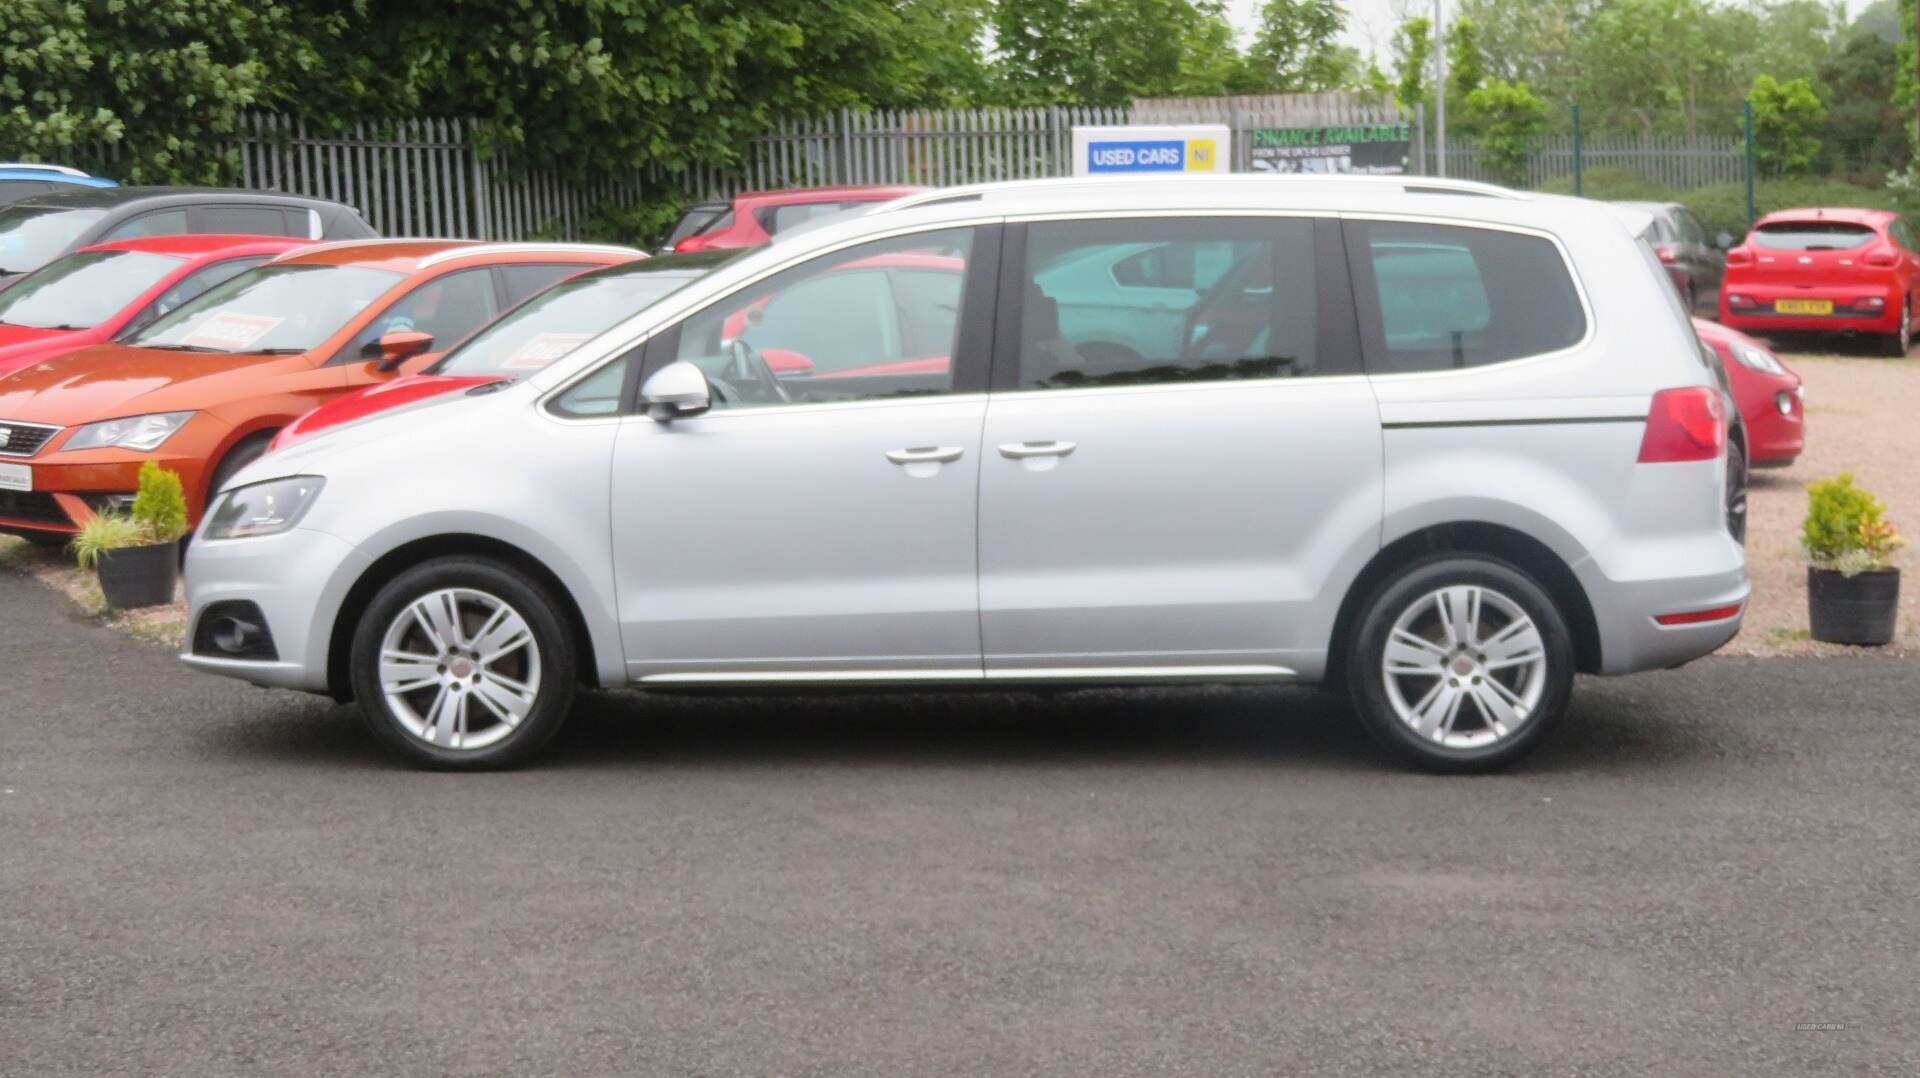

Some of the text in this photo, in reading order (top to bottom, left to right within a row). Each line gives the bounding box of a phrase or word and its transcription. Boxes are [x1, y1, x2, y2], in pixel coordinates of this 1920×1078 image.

[1253, 123, 1409, 145] FINANCE AVAILABLE
[1093, 149, 1134, 165] USED
[1137, 148, 1180, 164] CARS
